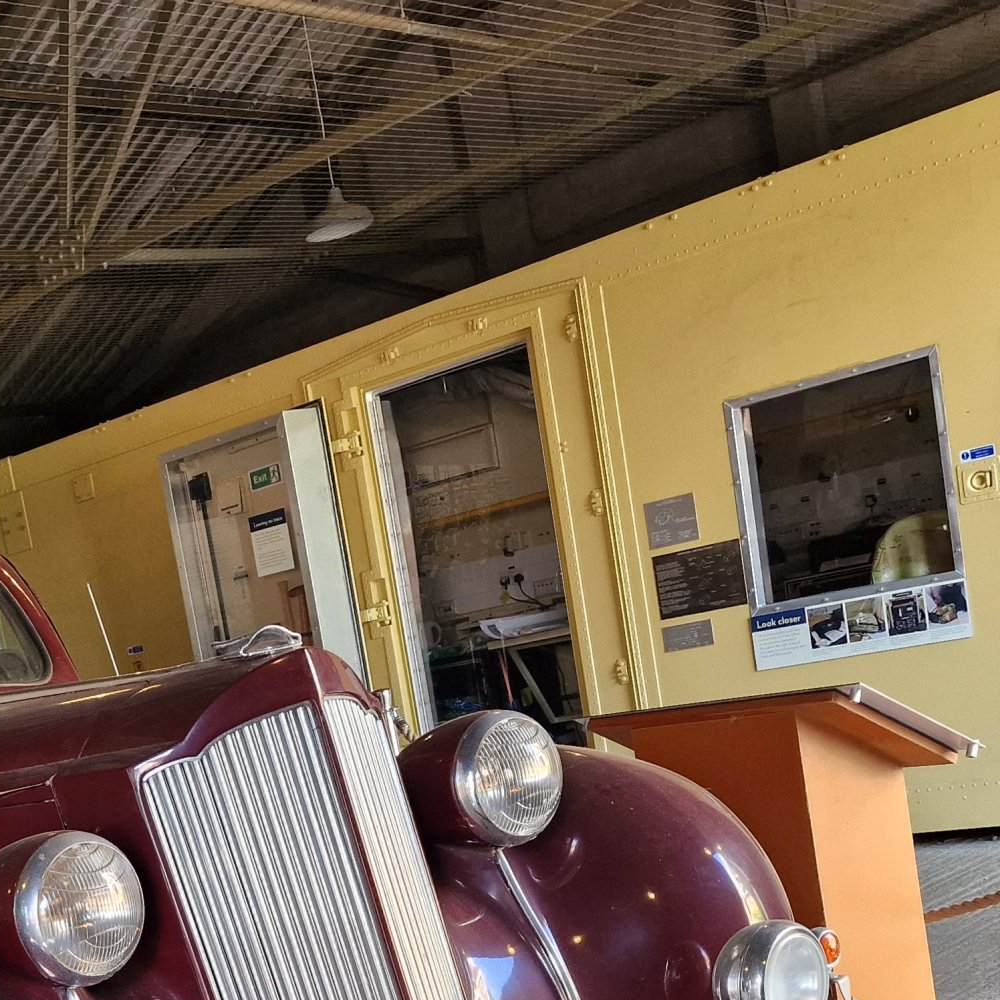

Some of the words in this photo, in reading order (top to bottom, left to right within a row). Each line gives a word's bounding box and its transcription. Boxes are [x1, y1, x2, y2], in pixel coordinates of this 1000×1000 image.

[253, 474, 267, 485] Exit
[756, 618, 776, 629] Look
[778, 616, 802, 625] closer
